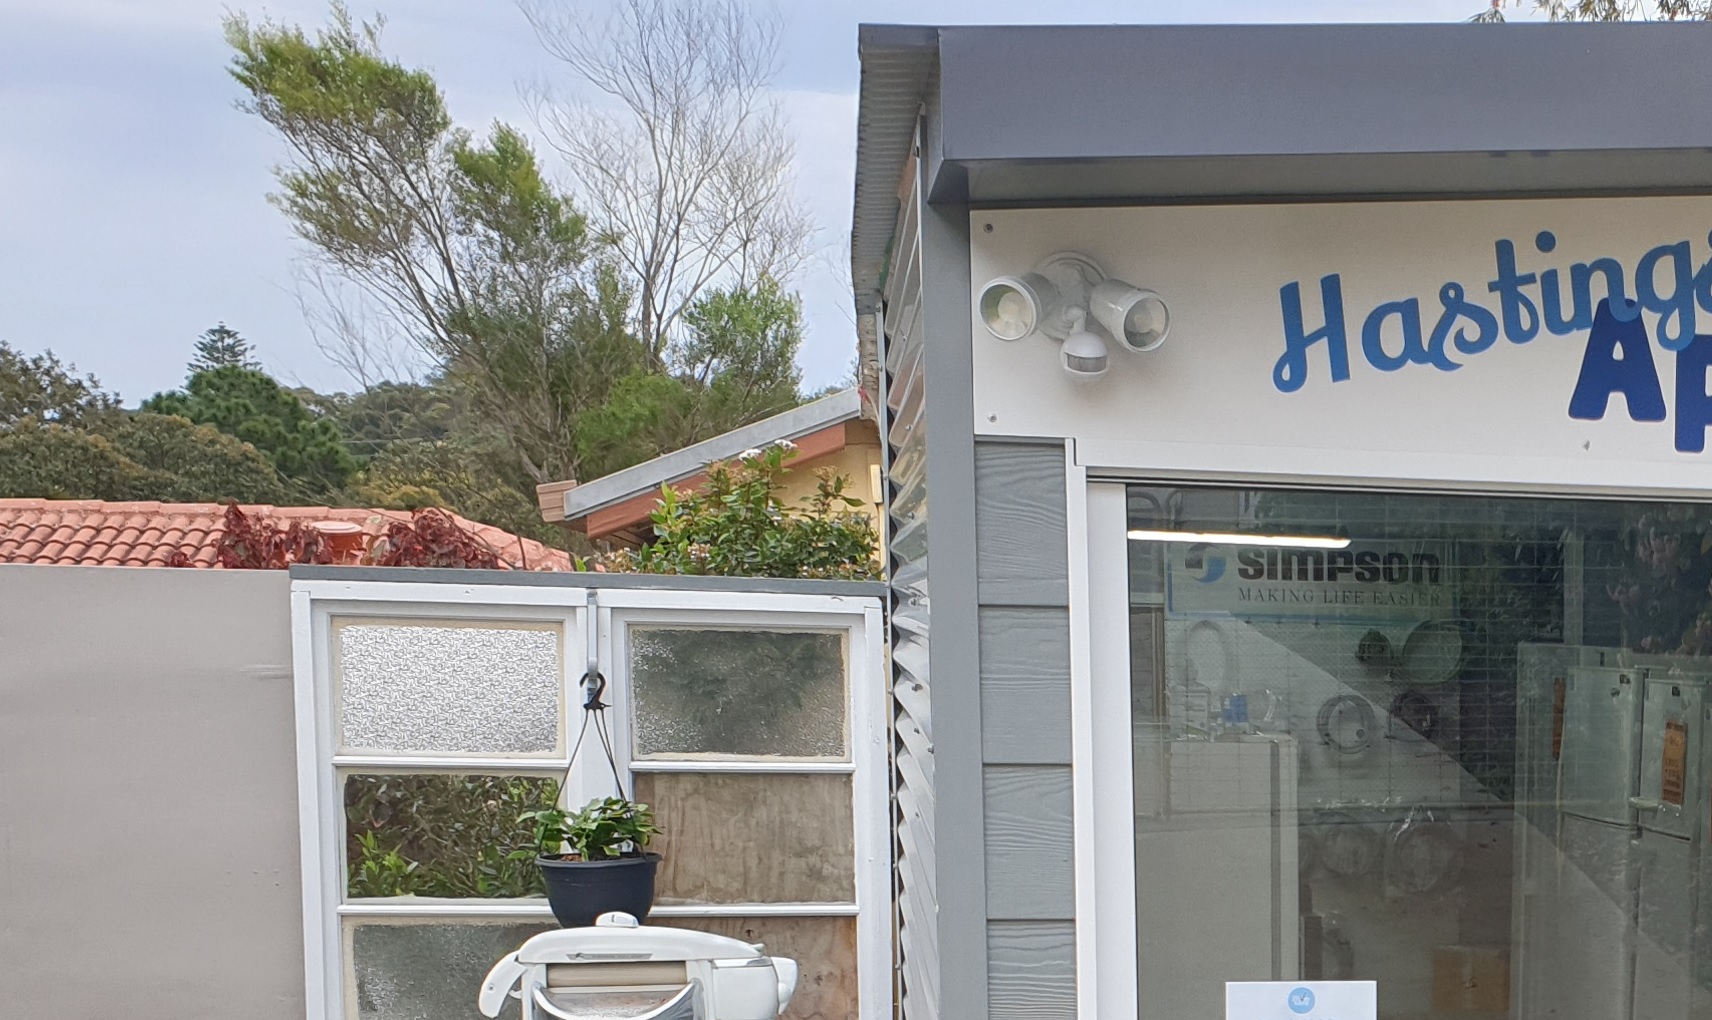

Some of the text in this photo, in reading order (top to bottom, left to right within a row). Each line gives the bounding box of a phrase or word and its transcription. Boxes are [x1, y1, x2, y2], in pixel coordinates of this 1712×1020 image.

[1239, 587, 1441, 607] MAKING LIFE EASIER
